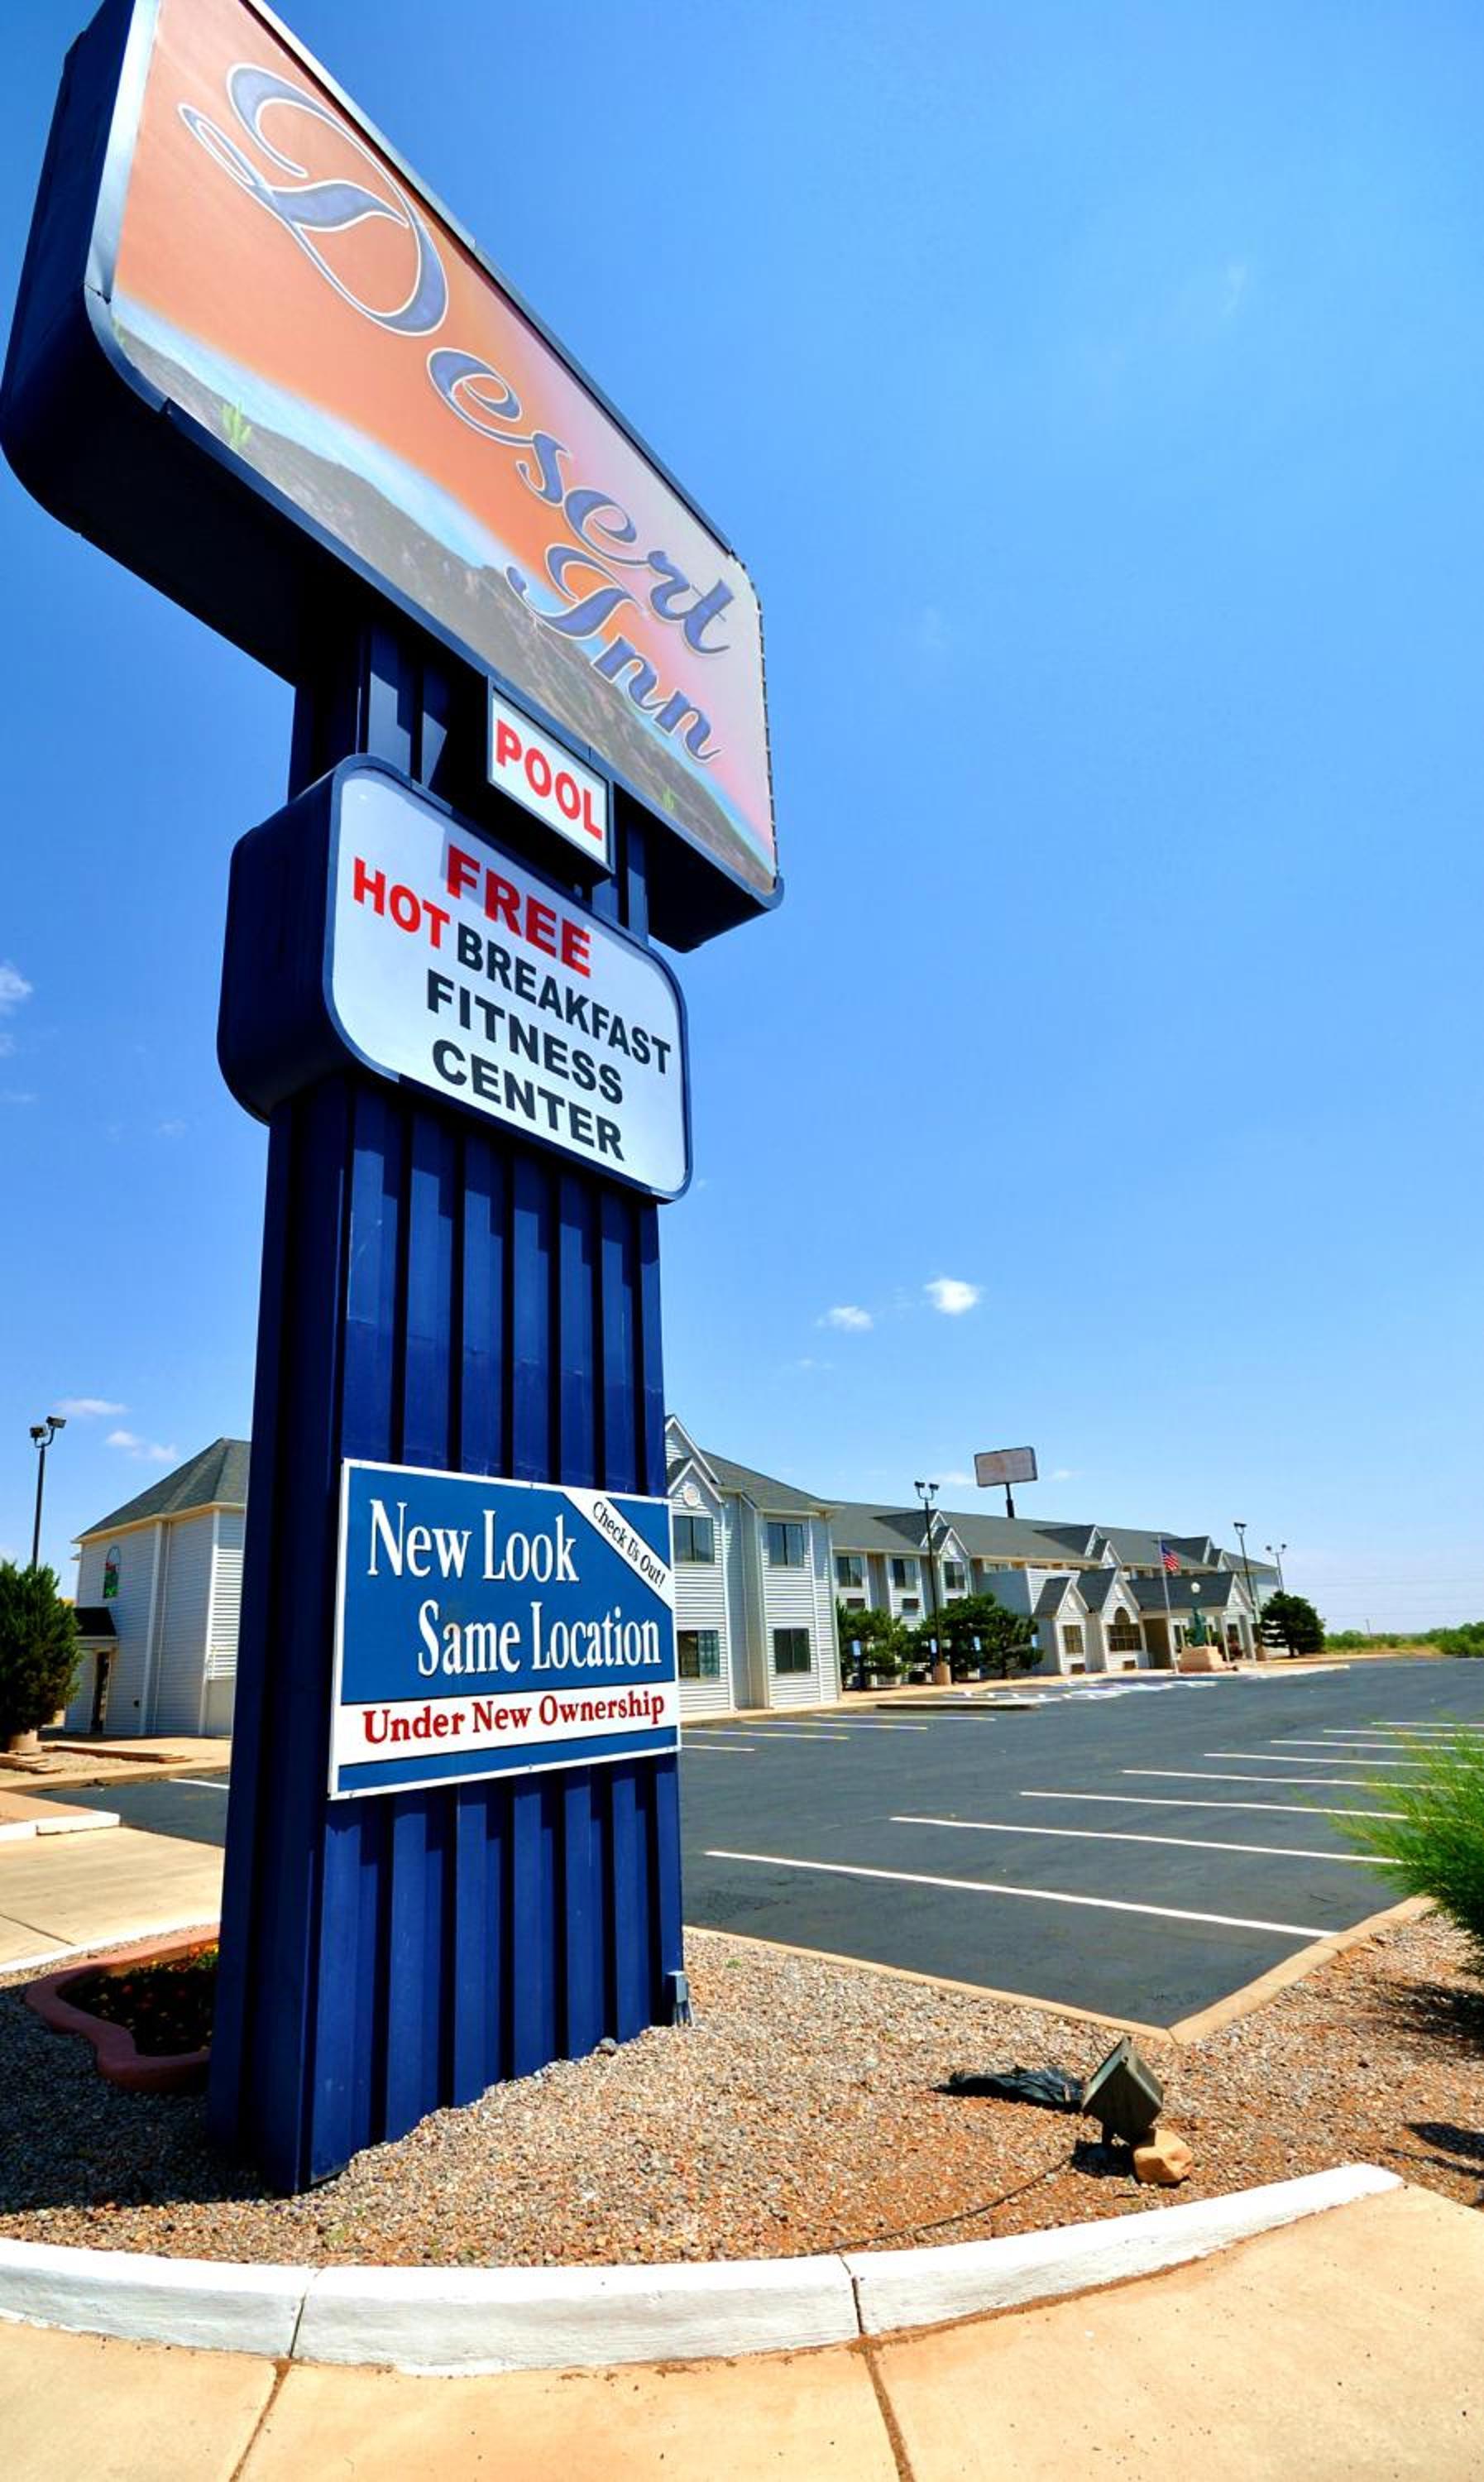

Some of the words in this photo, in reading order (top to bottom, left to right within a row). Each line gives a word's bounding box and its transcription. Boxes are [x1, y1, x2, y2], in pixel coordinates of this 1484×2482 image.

[177, 64, 731, 654] Desert
[505, 543, 722, 763] Inn
[495, 718, 603, 841] POOL
[352, 856, 451, 951] HOT
[456, 921, 672, 1076] BREAKFAST
[447, 843, 591, 978] FREE
[427, 968, 624, 1105] FITNESS
[432, 1037, 625, 1162] CENTER
[367, 1498, 472, 1579] New
[482, 1509, 580, 1583] Look
[593, 1502, 628, 1550] Check
[627, 1537, 640, 1562] Us
[639, 1555, 666, 1588] Out!
[418, 1599, 520, 1677] Same
[531, 1601, 662, 1670] Location
[362, 1705, 465, 1744] Under
[472, 1700, 531, 1733] New
[539, 1690, 665, 1723] Ownership
